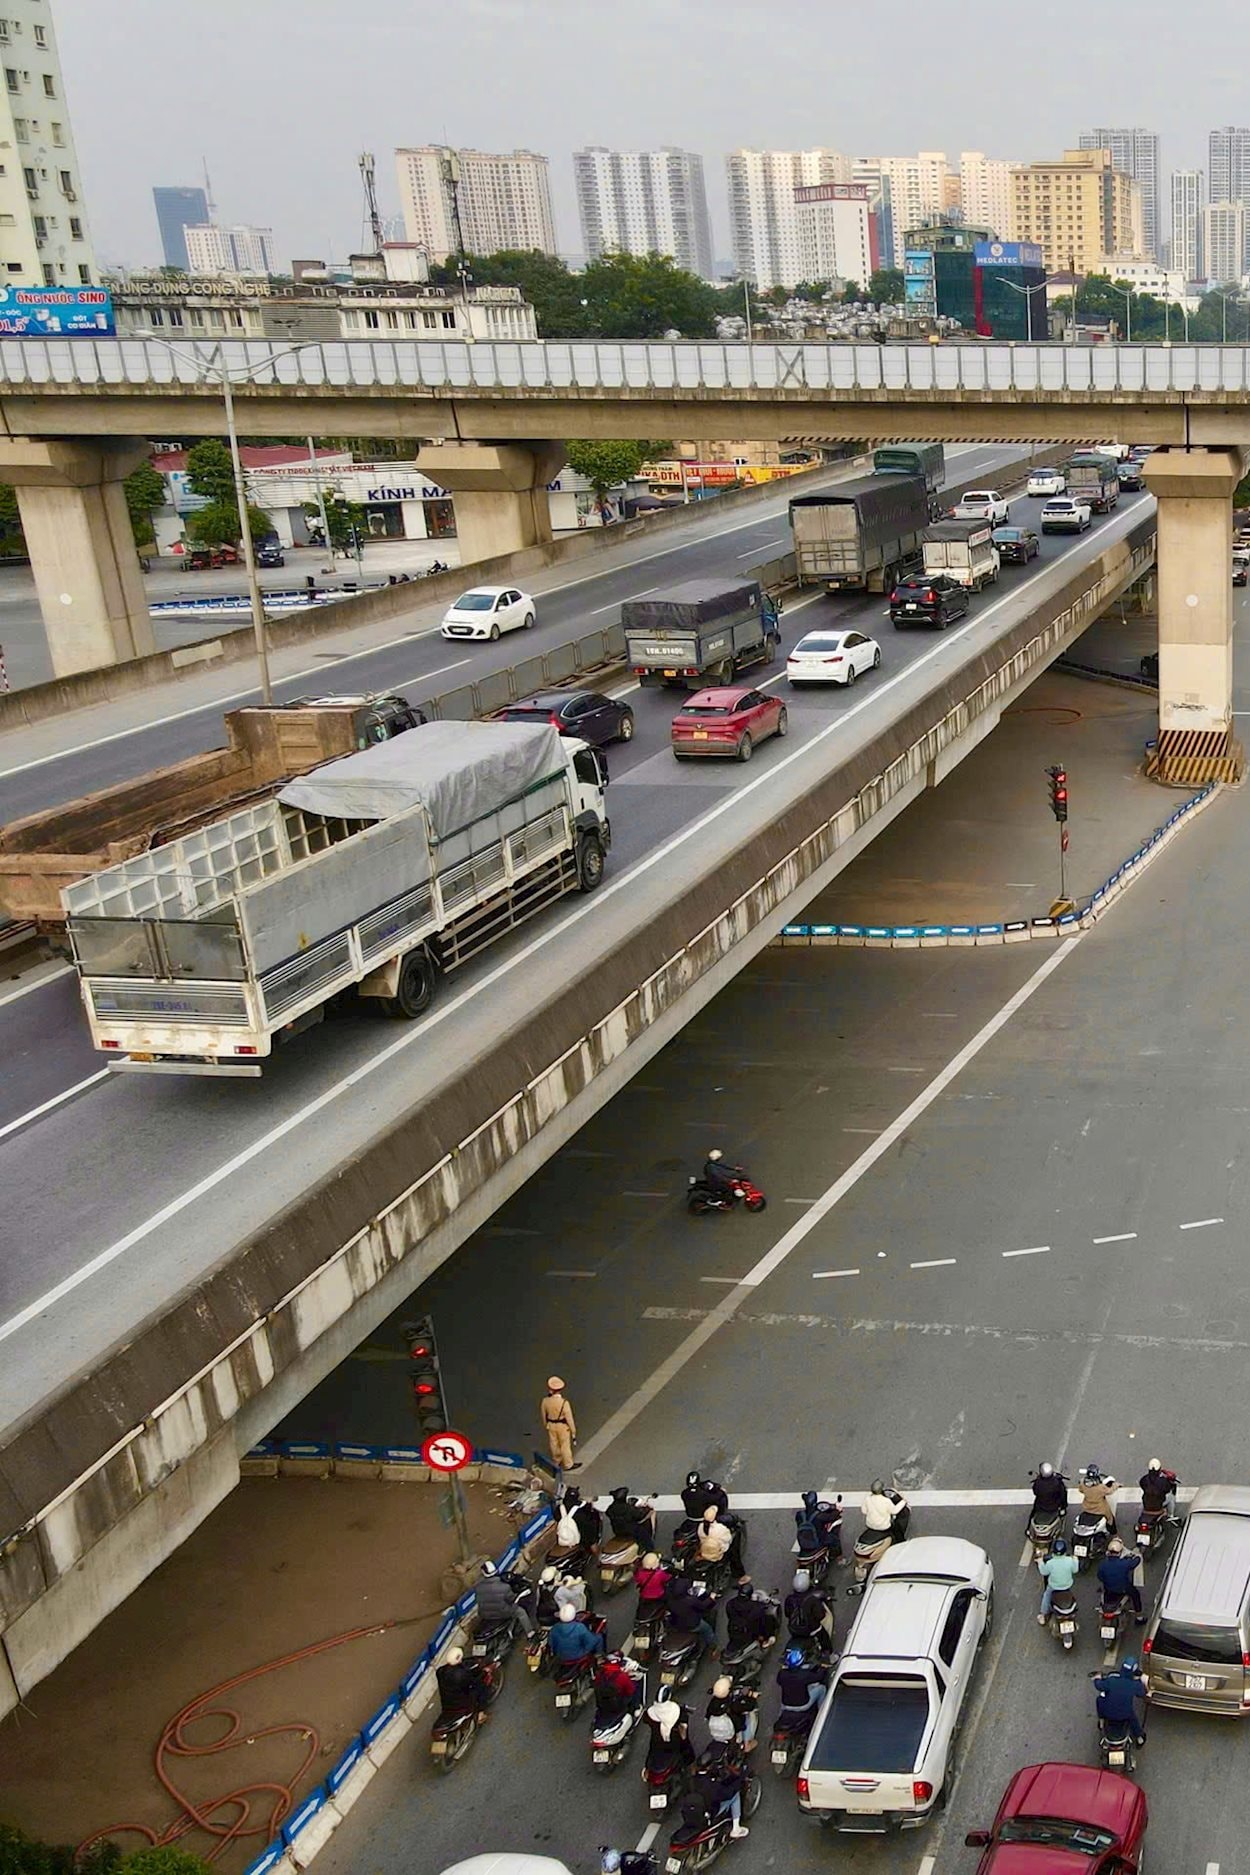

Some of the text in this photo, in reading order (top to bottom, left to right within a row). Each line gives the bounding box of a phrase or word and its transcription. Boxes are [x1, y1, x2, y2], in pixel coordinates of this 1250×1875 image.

[78, 292, 107, 304] SINO
[661, 472, 680, 480] DTH
[368, 485, 415, 501] KÍNH
